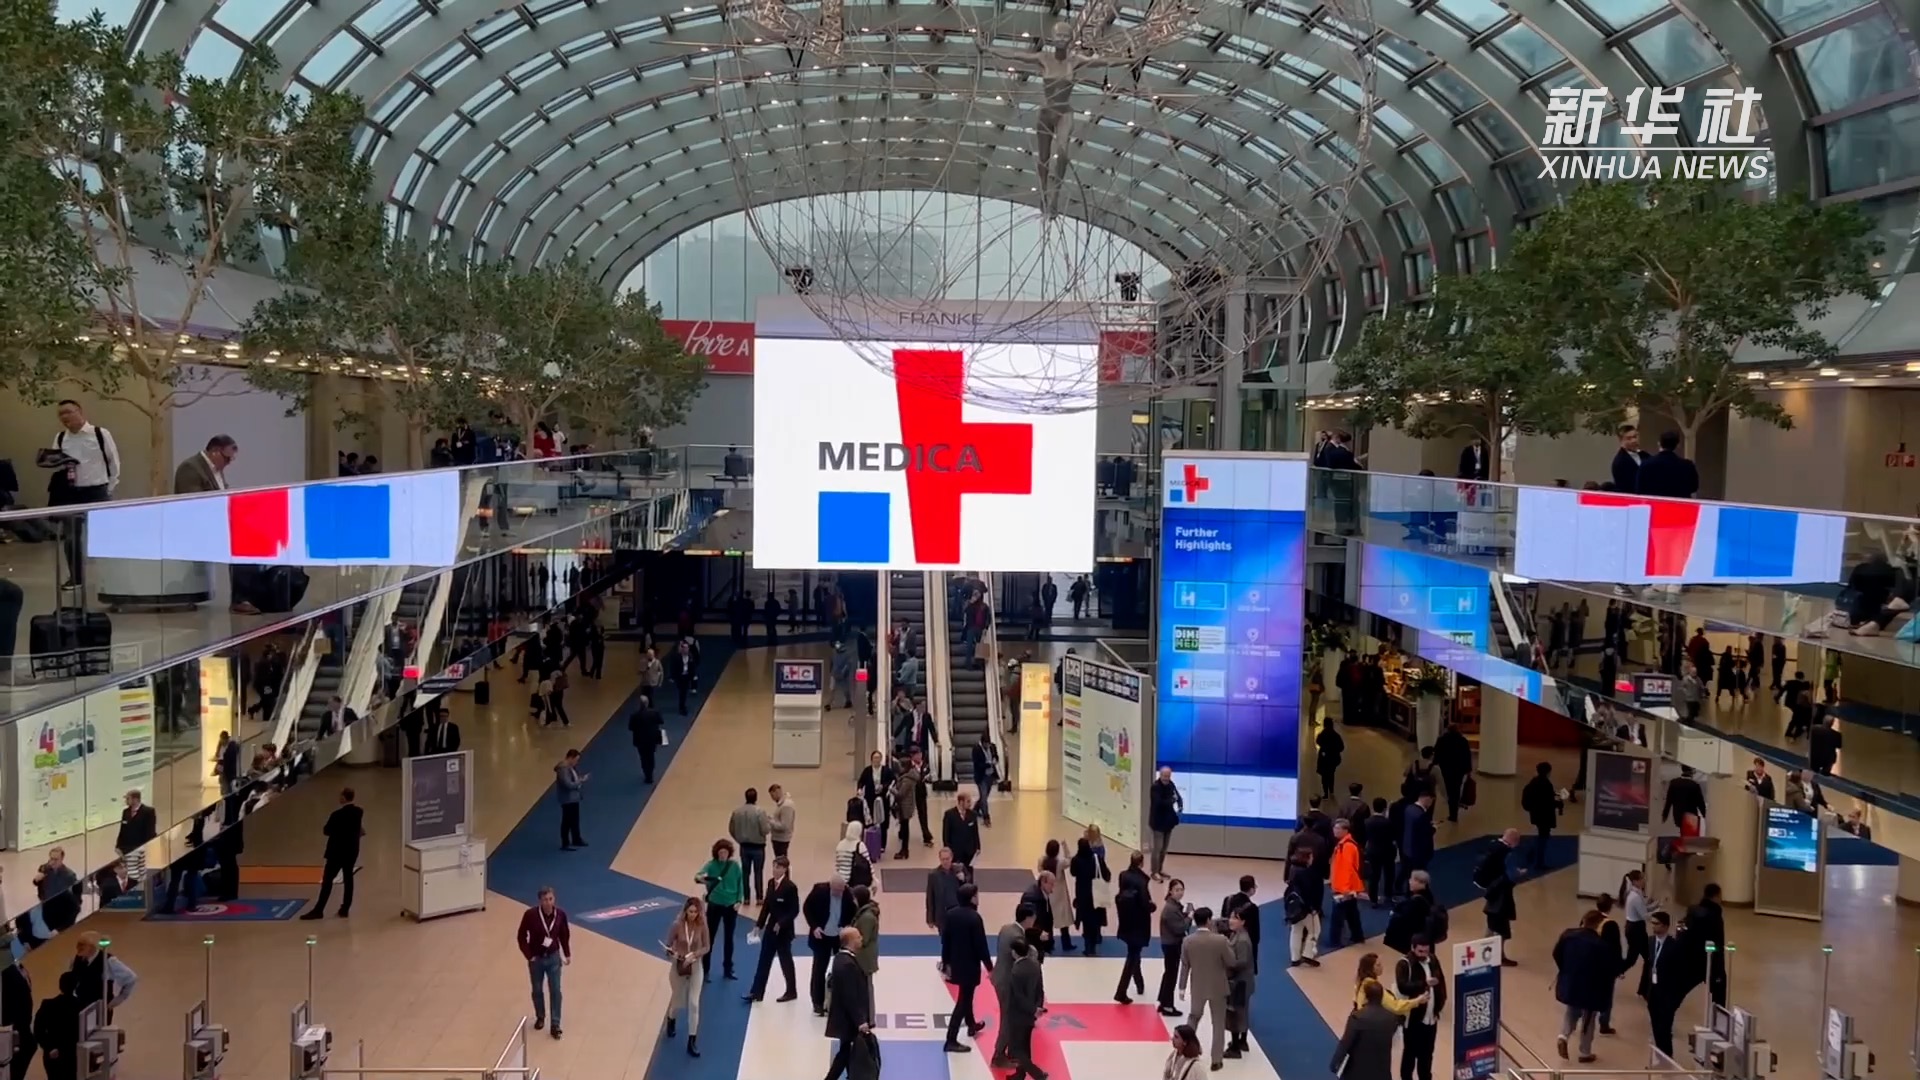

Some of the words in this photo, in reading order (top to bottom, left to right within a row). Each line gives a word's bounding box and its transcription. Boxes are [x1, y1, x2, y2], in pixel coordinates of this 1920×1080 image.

[899, 311, 984, 325] FRANKE
[736, 339, 749, 356] A
[818, 441, 983, 473] MEDICA
[1175, 526, 1219, 538] Further
[1175, 539, 1232, 552] Highlights
